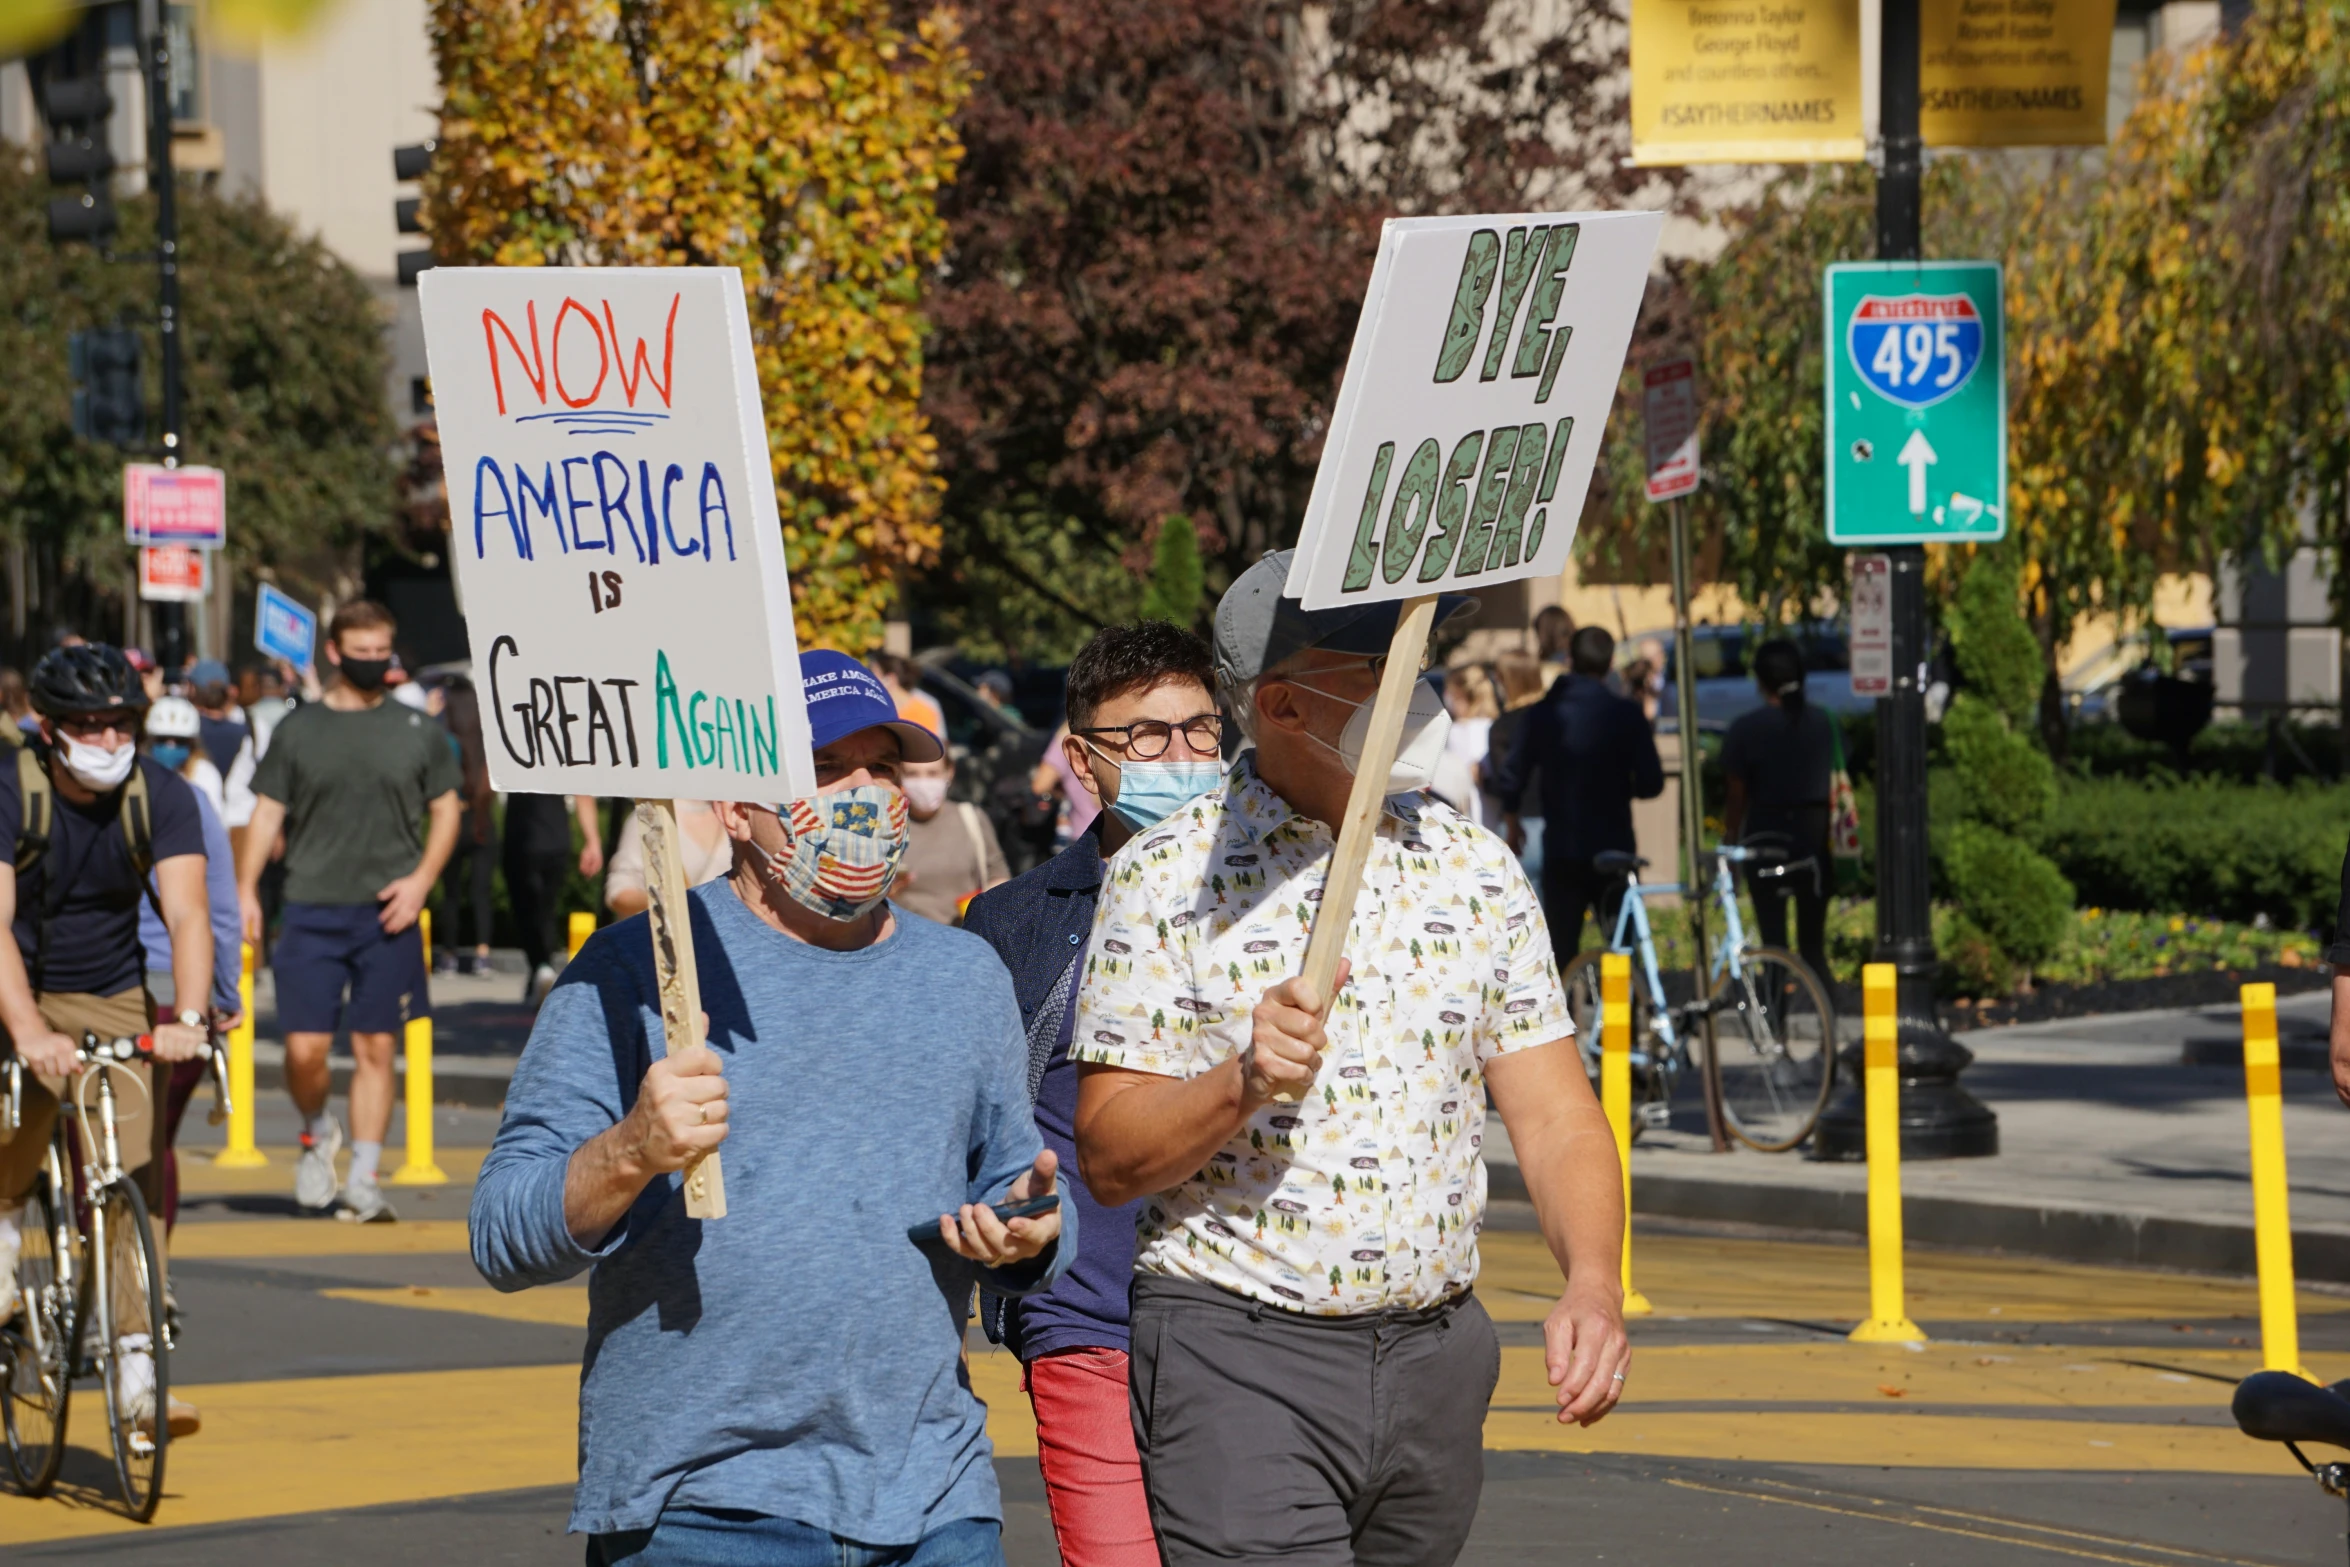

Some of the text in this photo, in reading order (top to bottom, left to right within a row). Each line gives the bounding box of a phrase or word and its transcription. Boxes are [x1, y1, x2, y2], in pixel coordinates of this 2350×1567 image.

[1692, 32, 1800, 56] George Floyd
[1760, 4, 1805, 30] Taylor
[1664, 63, 1692, 81] and
[1696, 63, 1766, 81] countless
[1661, 99, 1836, 126] #SAYTHEIRNAMES
[1433, 223, 1580, 404] BYE,
[482, 292, 681, 416] NOW
[1872, 323, 1963, 388] 495
[473, 450, 738, 566] AMERICA
[1341, 416, 1575, 593] LOSER!
[589, 570, 623, 614] IS
